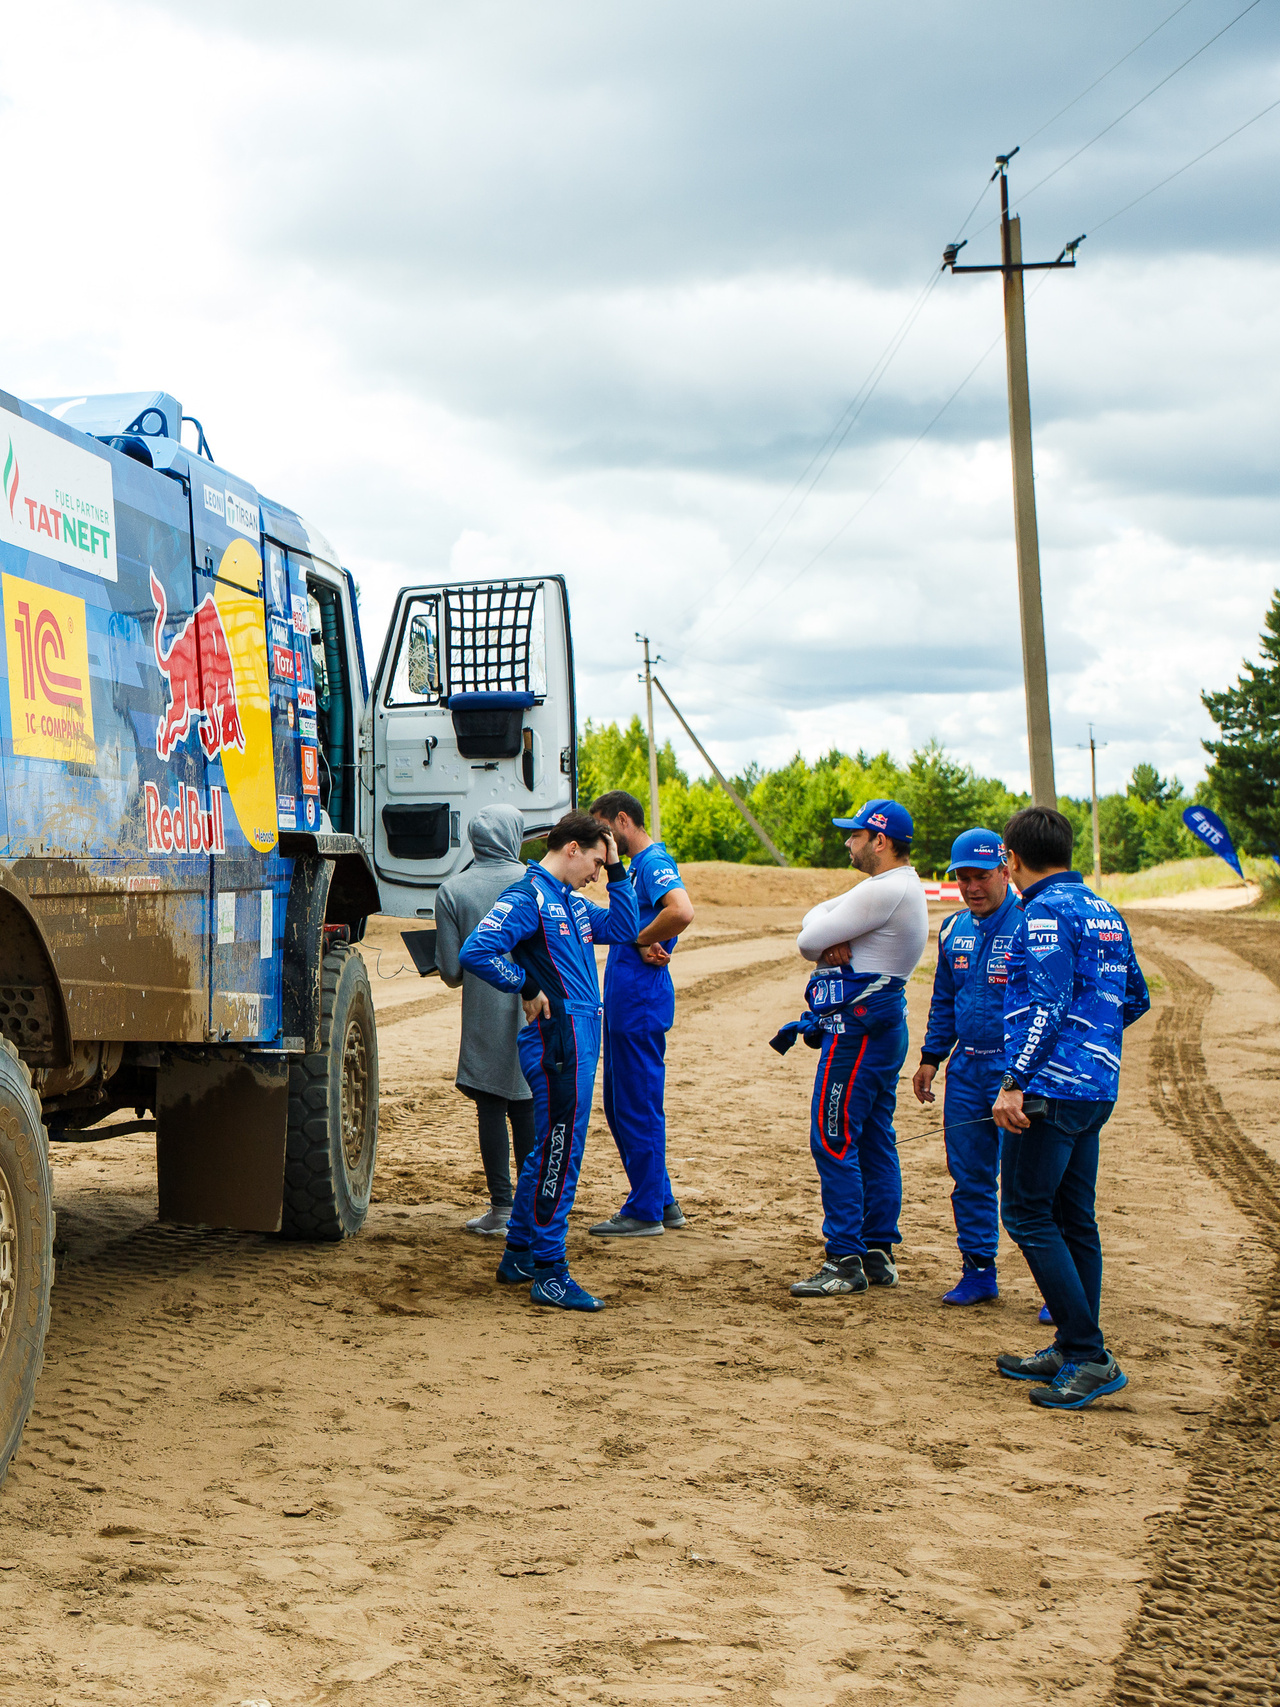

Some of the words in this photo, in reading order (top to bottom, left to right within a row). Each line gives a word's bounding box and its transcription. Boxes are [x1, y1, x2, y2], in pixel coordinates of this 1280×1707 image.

[24, 497, 110, 559] TATNEFT
[55, 489, 74, 511] FUEL
[76, 498, 110, 526] PARTNER
[204, 489, 224, 513] LEONI
[25, 713, 36, 735] 1C
[41, 715, 85, 742] COMPANY
[144, 782, 185, 853] Red
[187, 785, 226, 855] Bull
[1037, 933, 1059, 943] VTB
[1015, 1005, 1050, 1072] master
[828, 1082, 844, 1137] KAMAZ
[542, 1123, 566, 1198] KAMAZ
